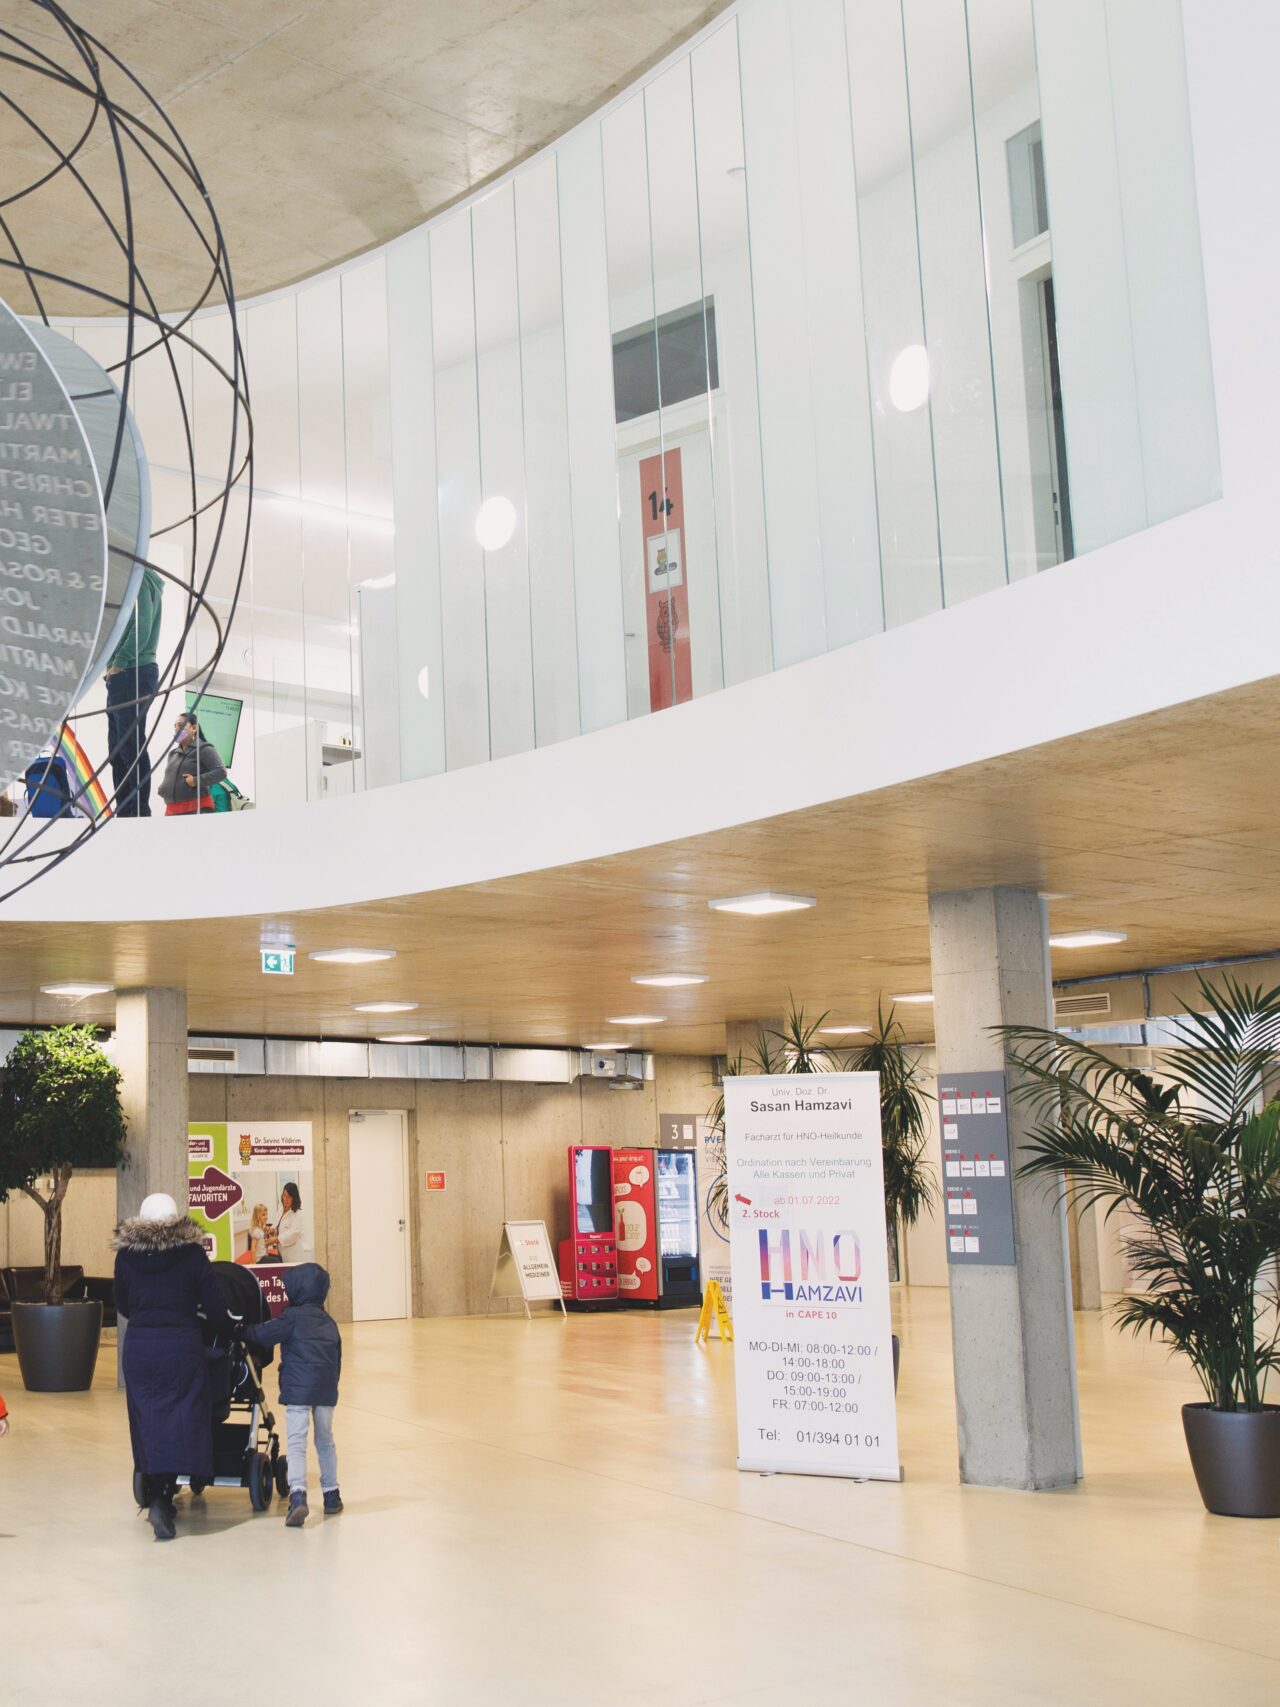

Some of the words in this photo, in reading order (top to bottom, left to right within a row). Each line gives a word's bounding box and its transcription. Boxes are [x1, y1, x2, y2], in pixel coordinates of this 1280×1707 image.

[750, 1100, 791, 1113] Sasan
[794, 1098, 853, 1111] Hamzavi
[671, 1124, 679, 1140] 3
[744, 1132, 781, 1142] Facharzt
[783, 1132, 794, 1141] für
[796, 1131, 863, 1141] HNO-Heilkunde
[704, 1135, 721, 1144] PVE
[736, 1158, 783, 1168] Ordination
[784, 1158, 807, 1167] nach
[809, 1157, 872, 1169] Vereinbarung
[753, 1170, 770, 1179] Alle
[772, 1170, 806, 1179] Kassen
[808, 1170, 826, 1179] und
[828, 1169, 856, 1179] Privat
[189, 1184, 201, 1192] und
[202, 1184, 236, 1193] Jugendärzte
[188, 1193, 228, 1202] FAVORITEN
[774, 1195, 785, 1205] ab
[787, 1195, 840, 1205] 01.07.2022
[741, 1209, 751, 1218] 2.
[753, 1209, 780, 1218] Stock
[758, 1229, 861, 1282] HNO
[266, 1291, 281, 1303] des
[761, 1282, 863, 1303] HAMZAVI
[786, 1309, 794, 1318] in
[797, 1310, 823, 1319] CAPE
[826, 1311, 837, 1320] 10
[749, 1341, 804, 1353] MO-DI-MI:
[806, 1343, 871, 1356] 08:00-12:00
[782, 1357, 845, 1369] 14:00-18:00
[767, 1370, 788, 1381] DO:
[790, 1371, 855, 1384] 09:00-13:00
[783, 1386, 847, 1398] 15:00-19:00
[772, 1399, 791, 1410] FR:
[794, 1400, 859, 1413] 07:00-12:00
[758, 1428, 781, 1441] Tel:
[796, 1430, 840, 1445] 01/394
[844, 1433, 859, 1446] 01
[865, 1435, 880, 1447] 01
